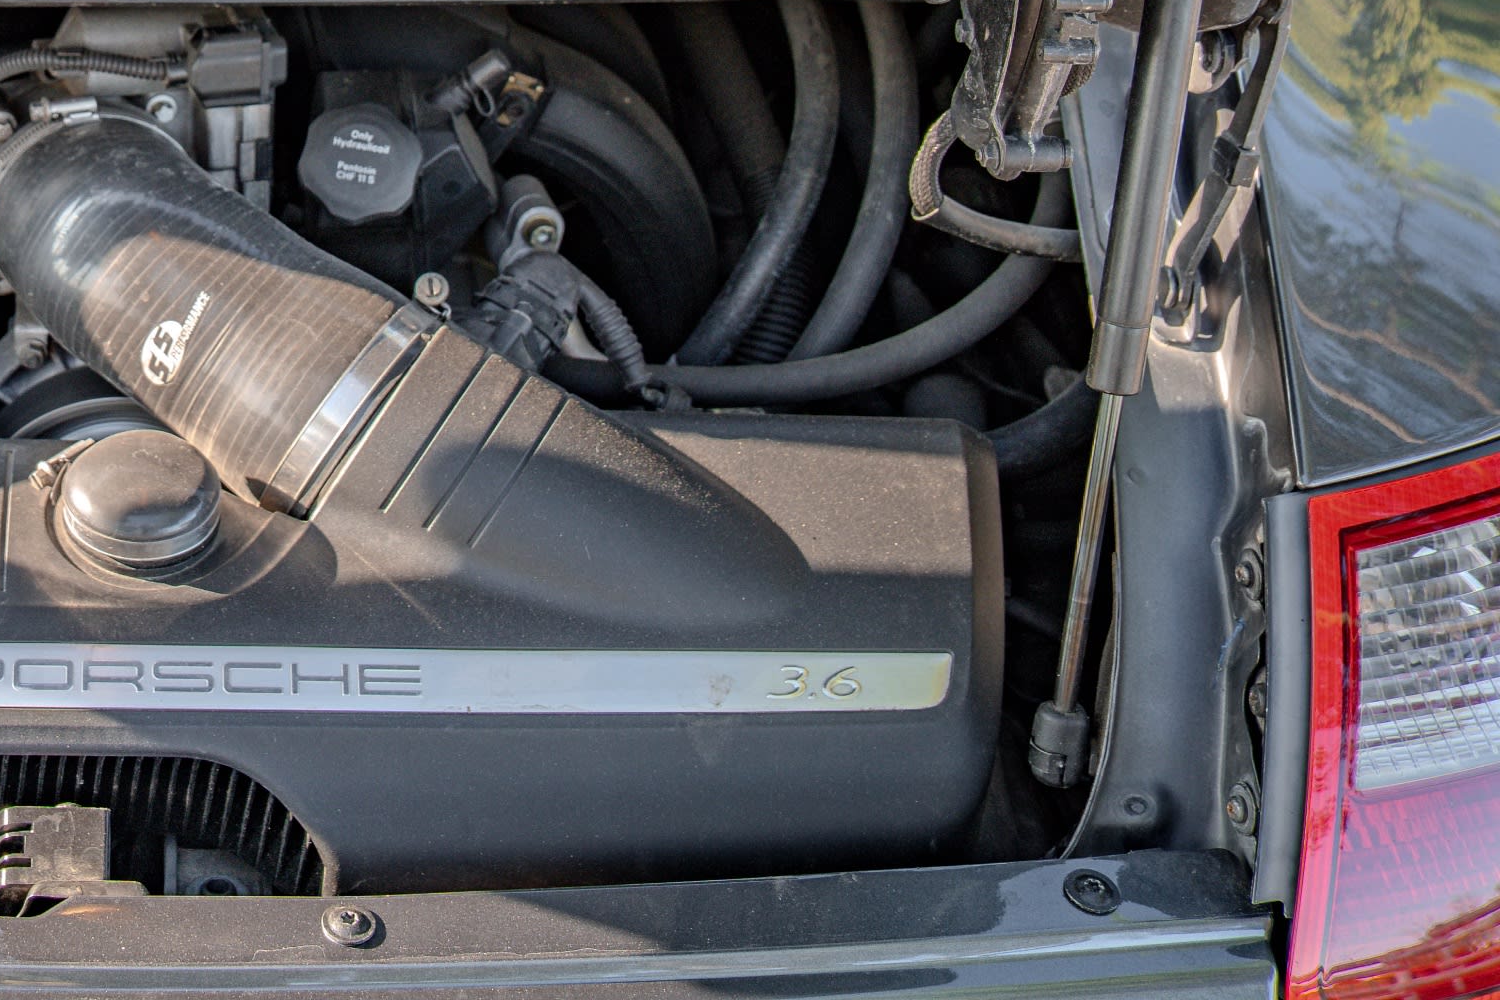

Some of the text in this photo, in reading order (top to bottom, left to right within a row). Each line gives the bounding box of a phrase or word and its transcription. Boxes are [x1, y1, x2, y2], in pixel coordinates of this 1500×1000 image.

[351, 129, 374, 142] Only
[336, 170, 355, 181] CHF
[337, 160, 378, 176] Pentosin
[171, 290, 211, 361] PERFORMANCE
[765, 664, 862, 700] 3.6
